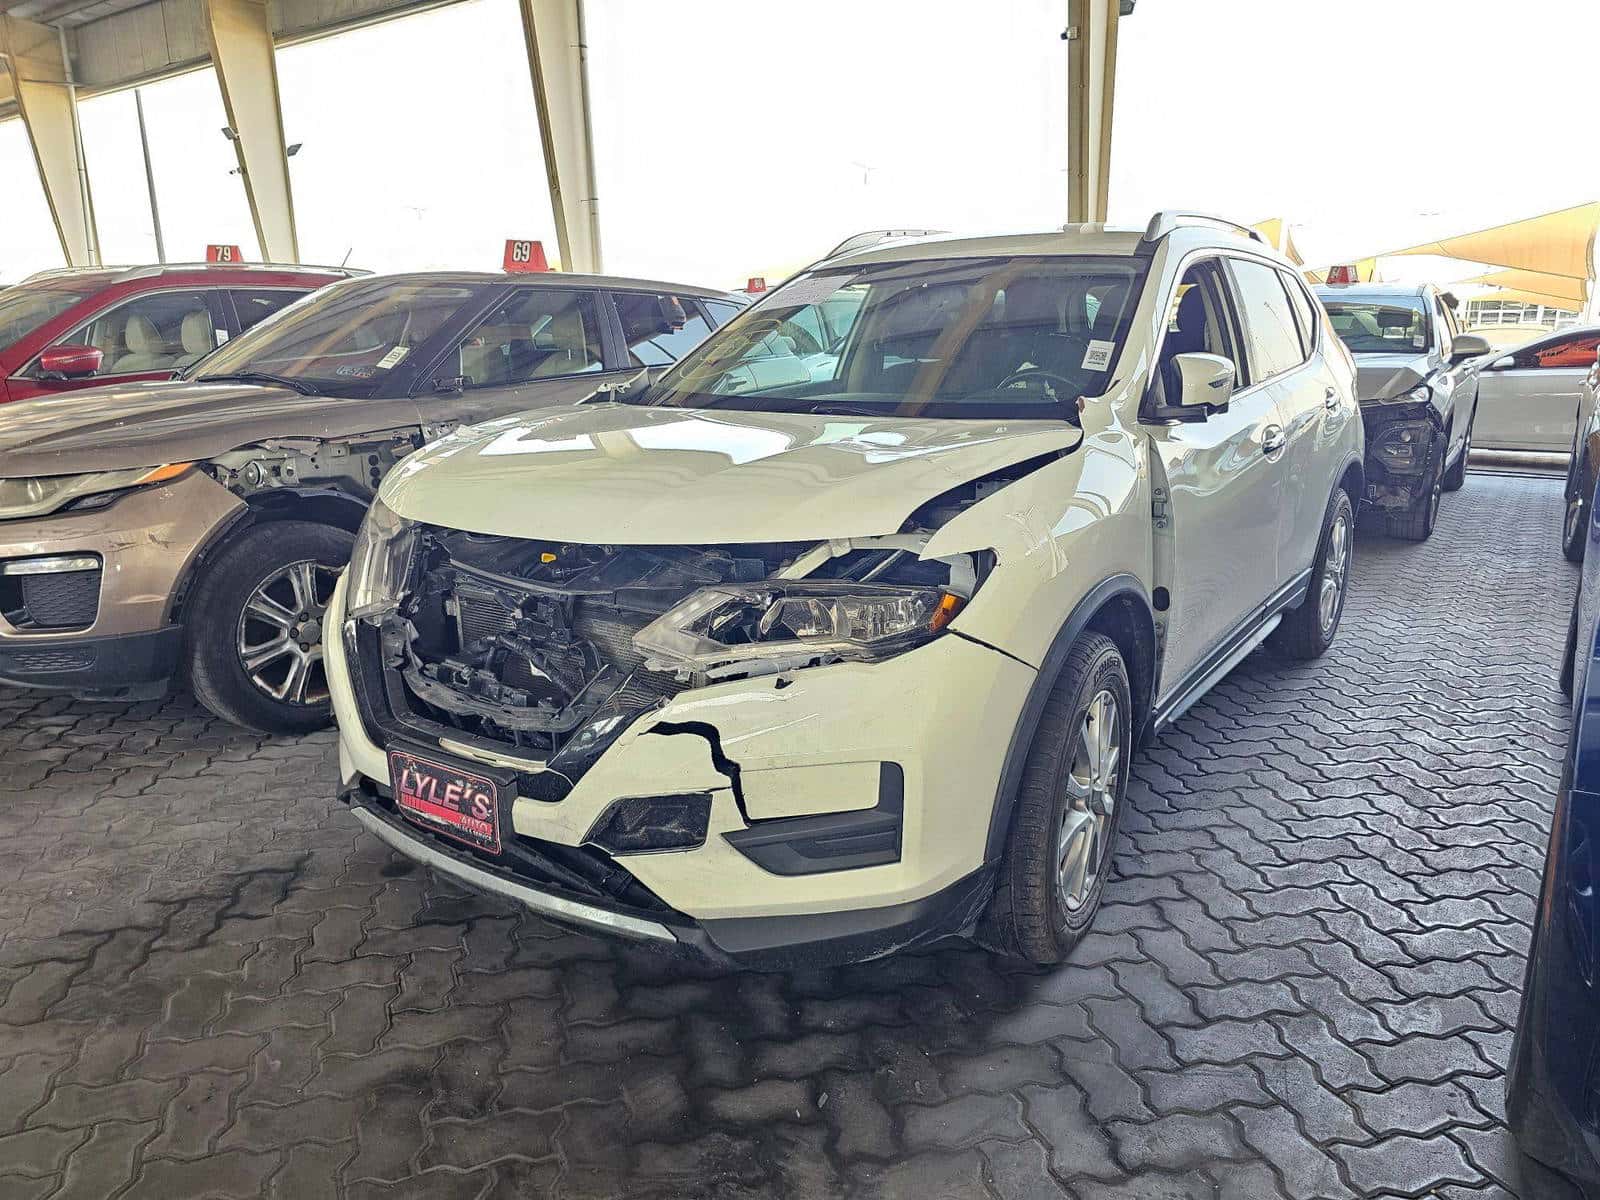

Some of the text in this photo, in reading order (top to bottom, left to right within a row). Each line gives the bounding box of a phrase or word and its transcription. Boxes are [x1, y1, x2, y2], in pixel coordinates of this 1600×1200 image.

[215, 246, 232, 262] 79
[513, 241, 531, 262] 69
[400, 769, 490, 820] LYLE'S
